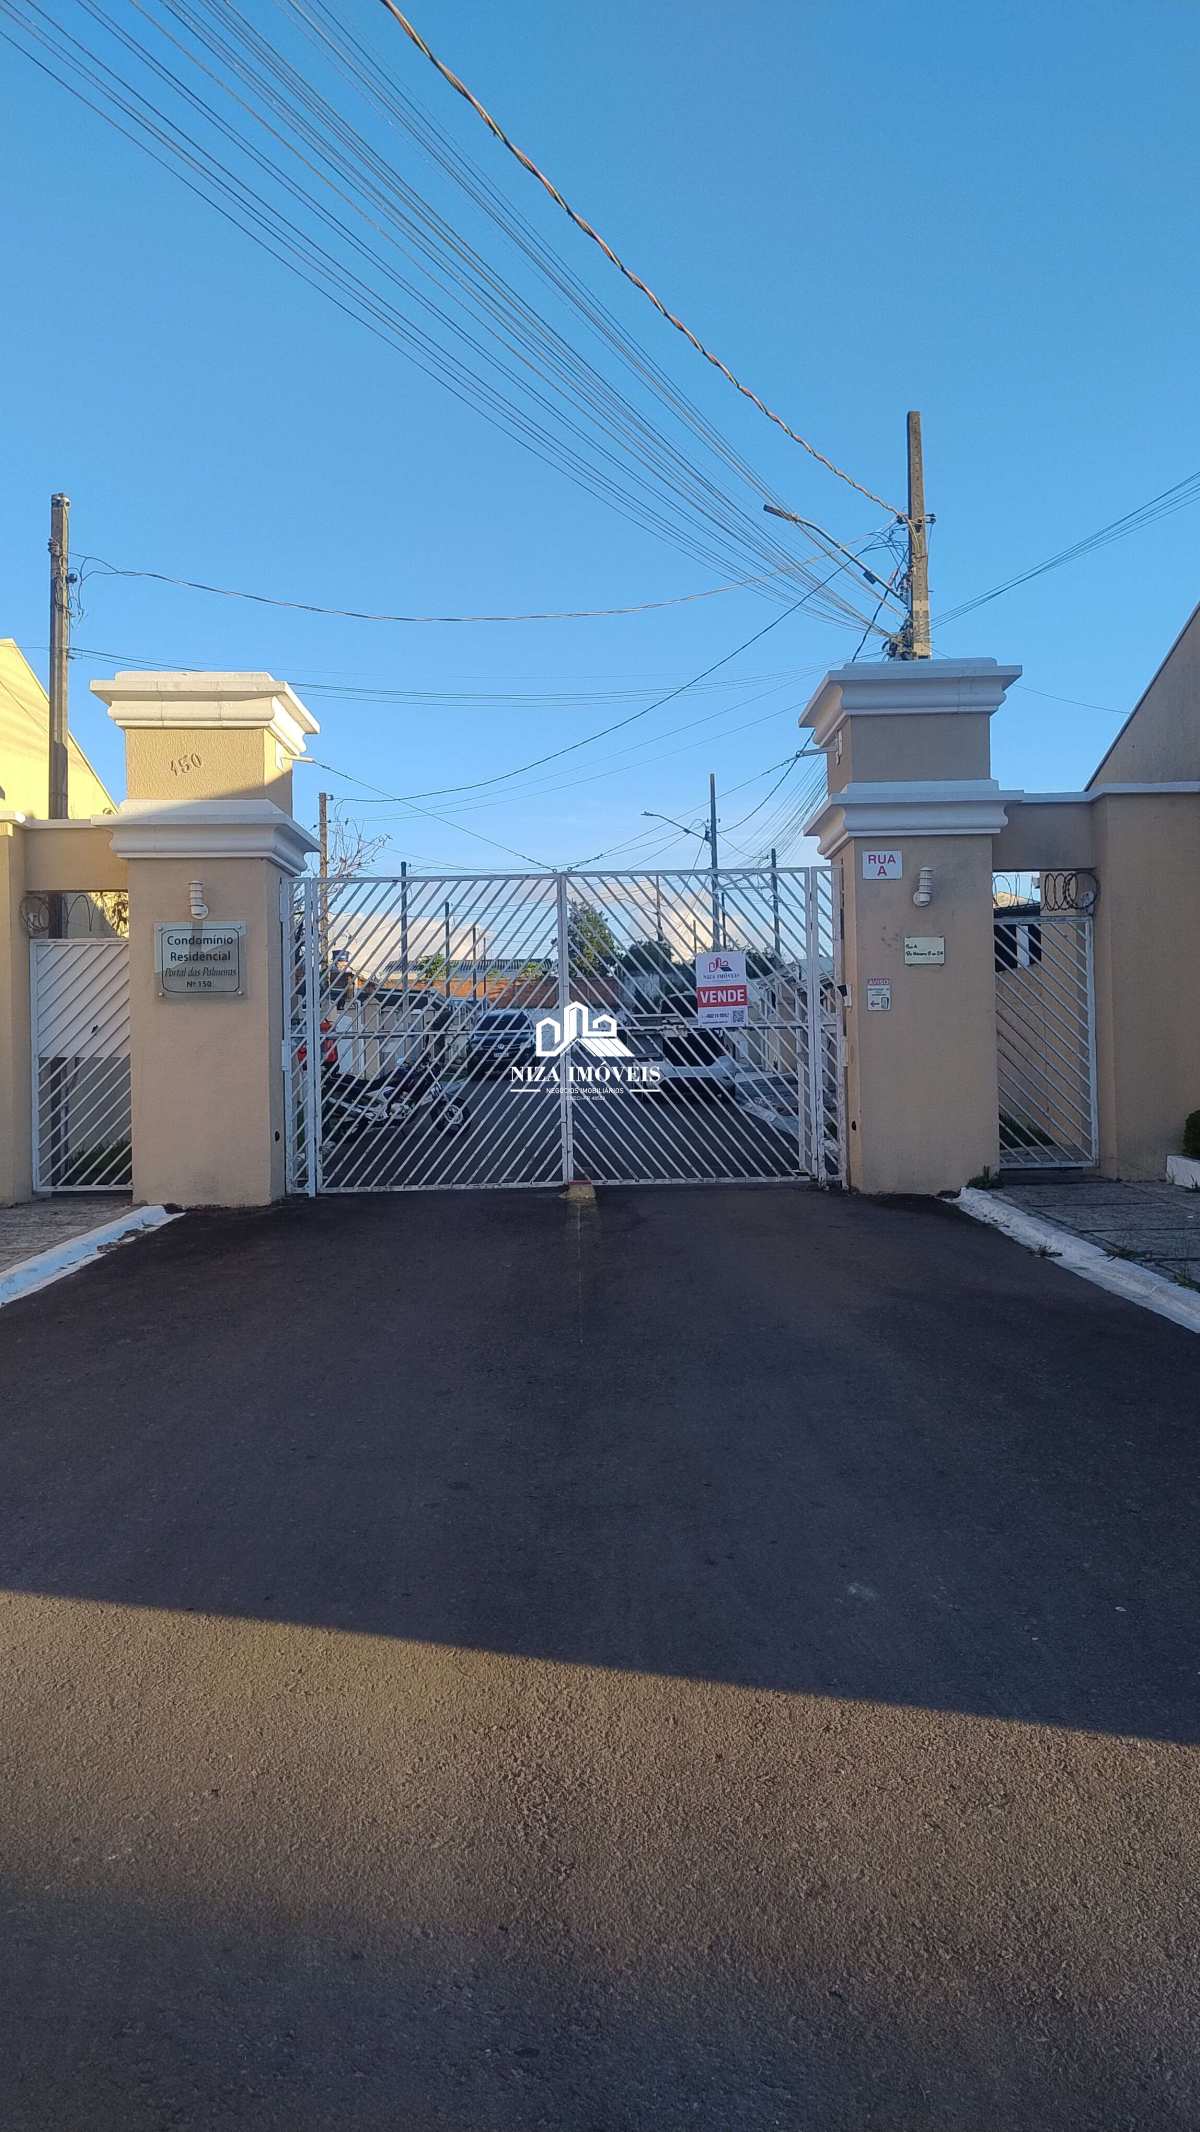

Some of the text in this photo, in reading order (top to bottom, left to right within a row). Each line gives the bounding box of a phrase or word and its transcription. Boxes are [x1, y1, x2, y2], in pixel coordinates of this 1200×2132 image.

[868, 854, 896, 864] RUA
[877, 865, 888, 877] A
[167, 935, 234, 945] Condomínio
[170, 951, 231, 961] Residencial
[700, 988, 745, 1004] VENDE
